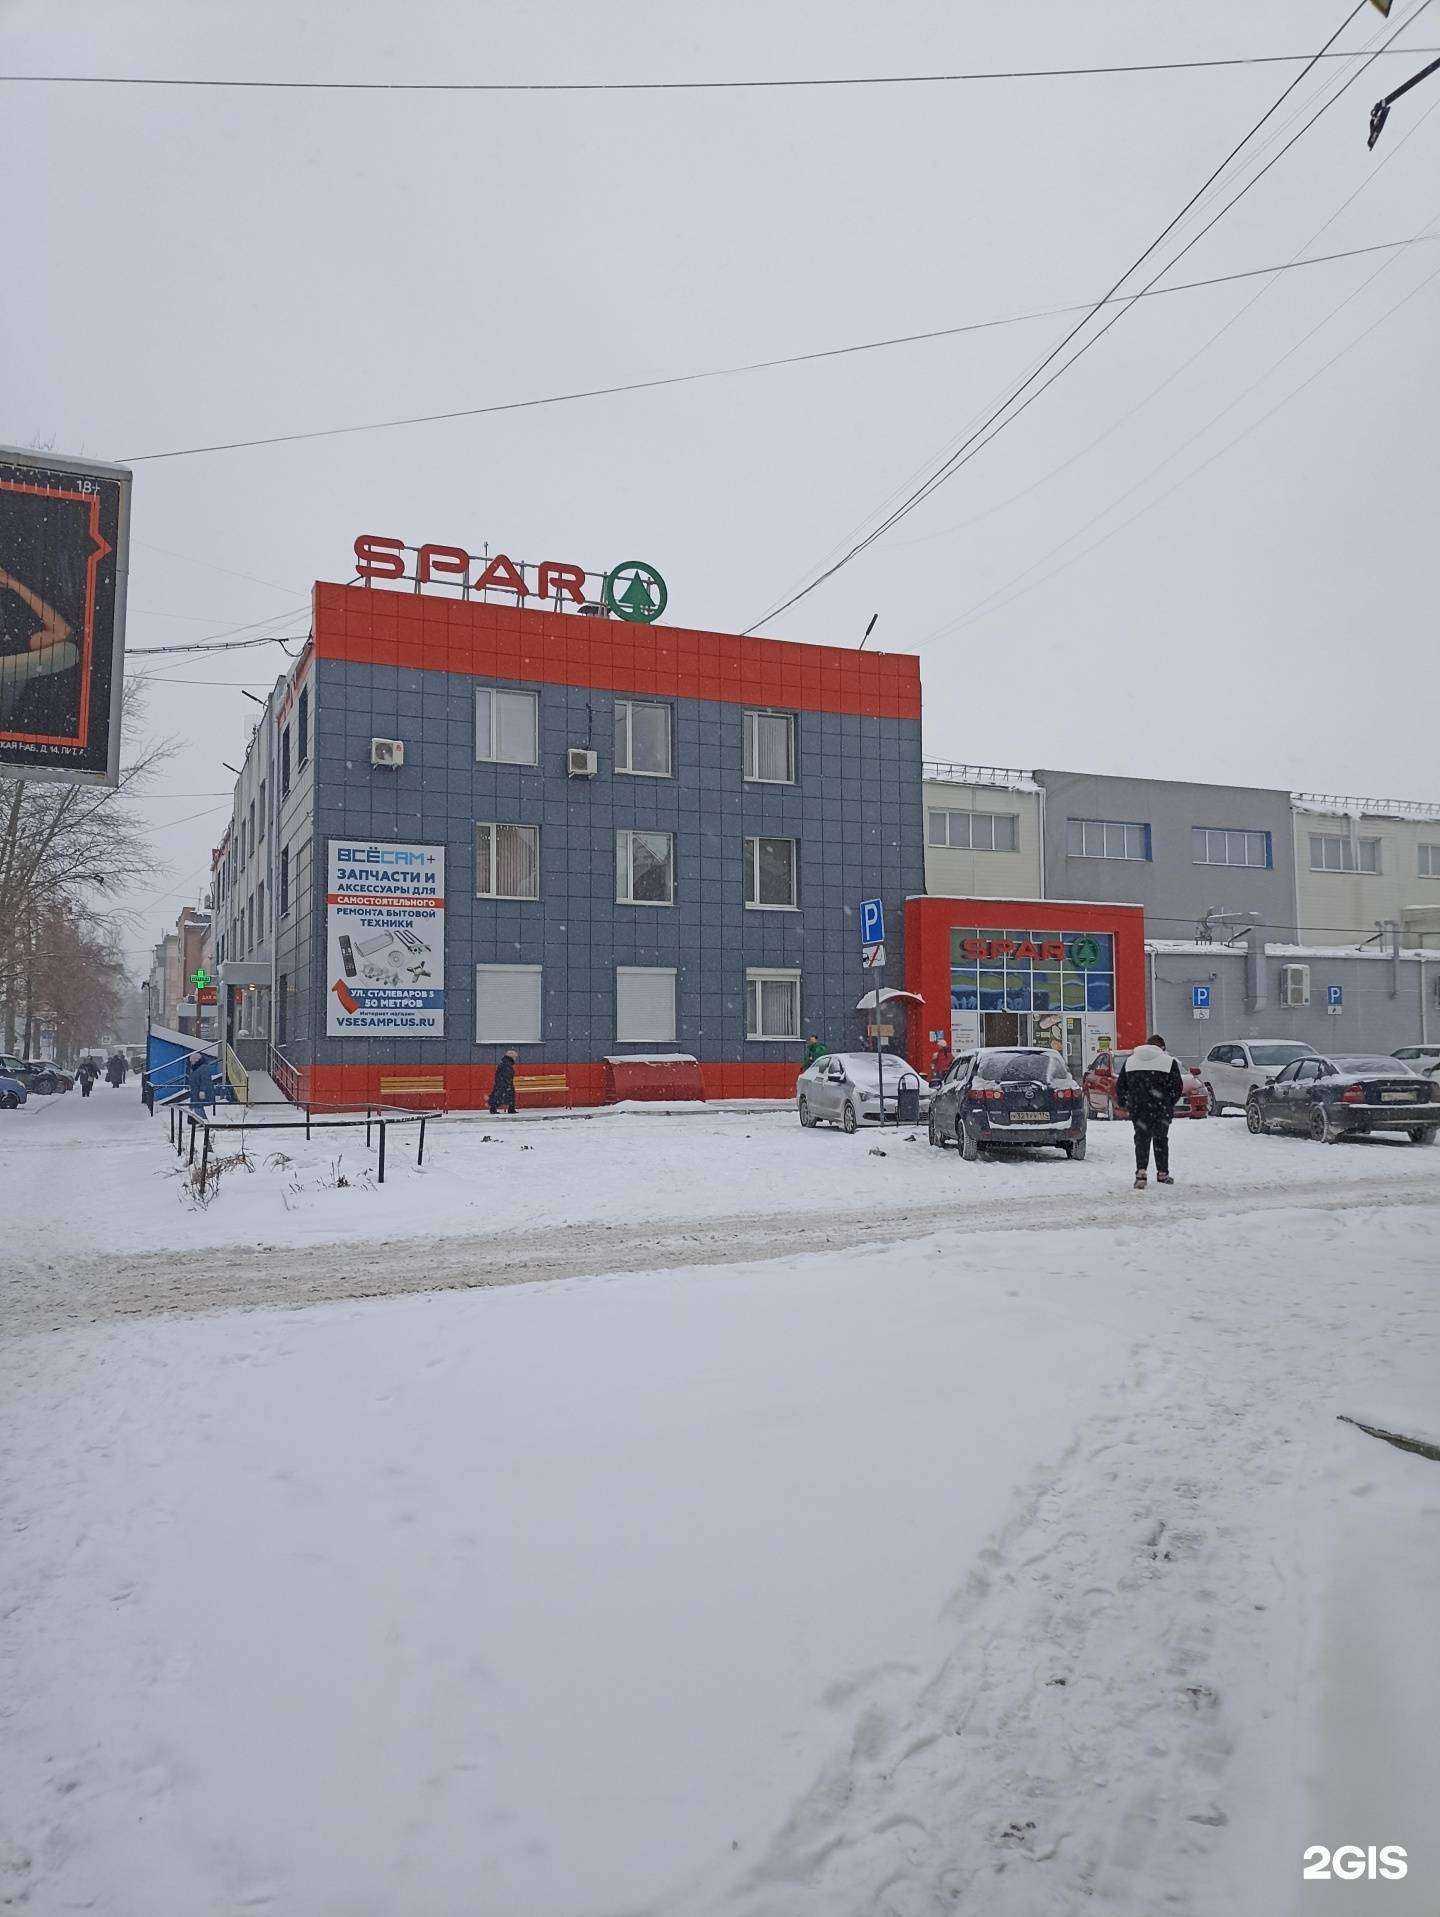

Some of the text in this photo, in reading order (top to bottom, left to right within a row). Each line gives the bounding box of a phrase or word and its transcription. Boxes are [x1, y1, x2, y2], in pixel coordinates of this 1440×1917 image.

[76, 480, 100, 493] 18+
[353, 534, 586, 604] SPAR
[337, 868, 436, 884] ЗАПЧАСТИ И
[337, 884, 436, 896] АКСЕССУАРЫ ДЛЯ
[337, 896, 436, 907] САМОСТОЯТЕЛЬНОГО
[337, 907, 436, 918] РЕМОНТА БЫТОВОЙ
[360, 918, 414, 928] ТЕХНИКИ
[959, 938, 1065, 961] SPAR
[350, 989, 366, 997] УЛ.
[367, 990, 428, 998] СТАЛЕВАРОВ
[364, 999, 424, 1008] 50 МЕТРОВ
[336, 1017, 435, 1027] VSESAMPLUS.RU
